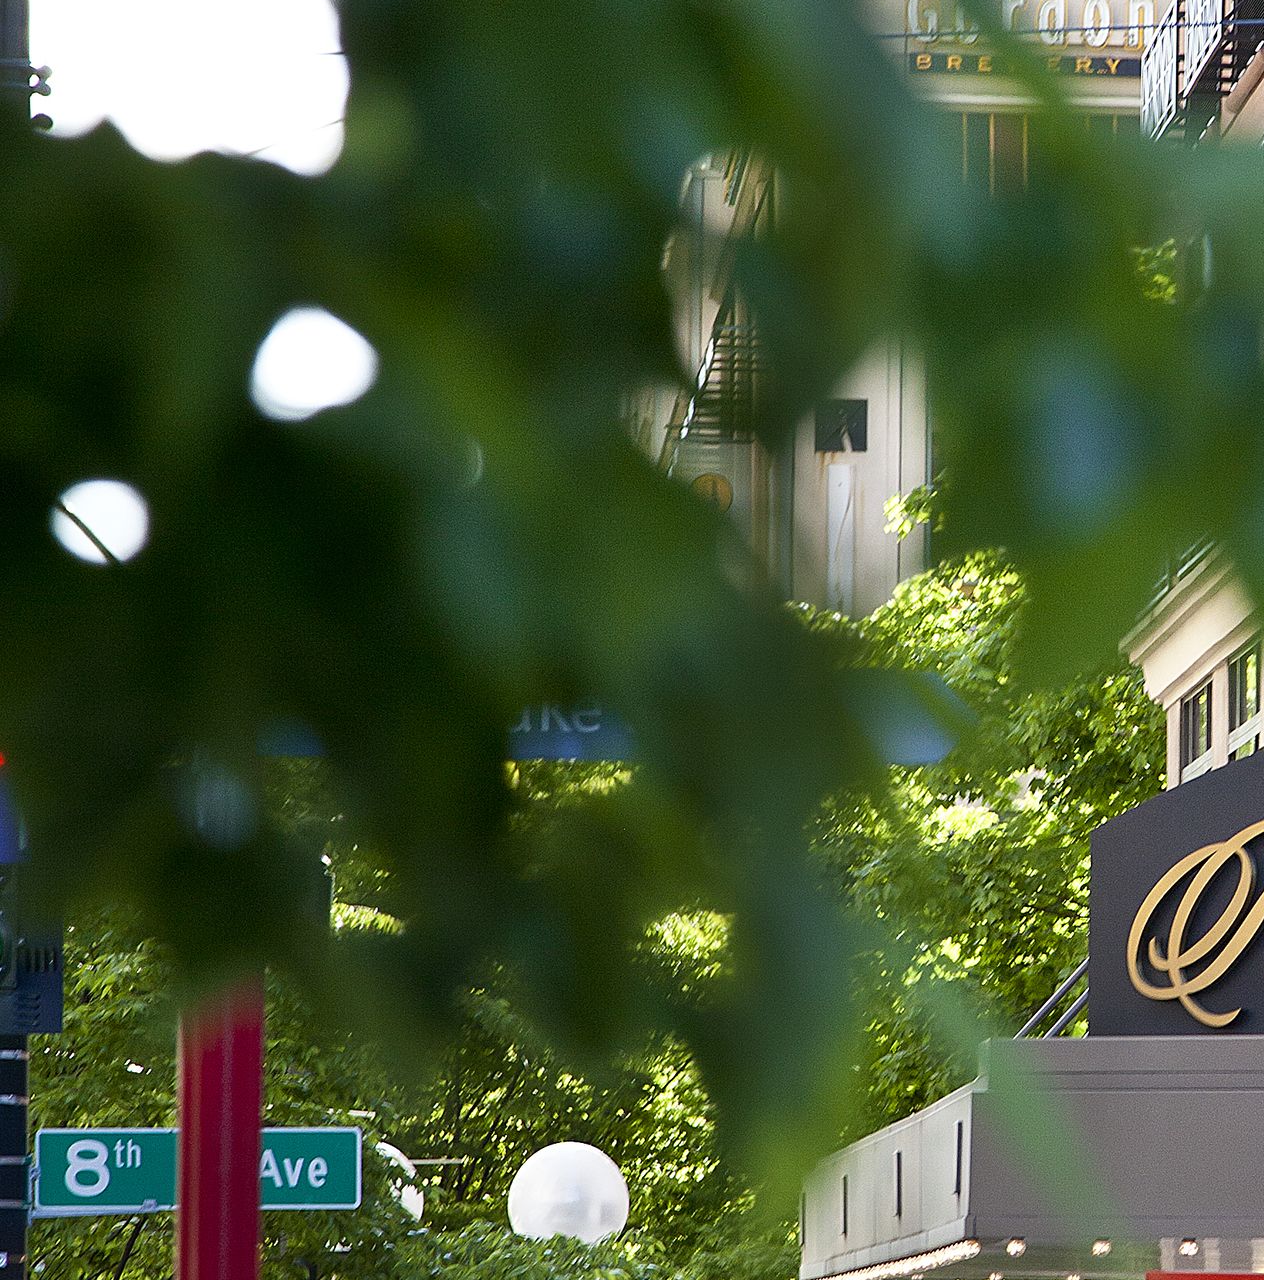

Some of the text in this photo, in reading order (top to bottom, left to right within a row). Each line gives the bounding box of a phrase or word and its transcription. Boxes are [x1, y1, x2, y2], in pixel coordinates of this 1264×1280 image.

[915, 54, 1121, 75] BREERY
[64, 1138, 328, 1197] 8th Ave
